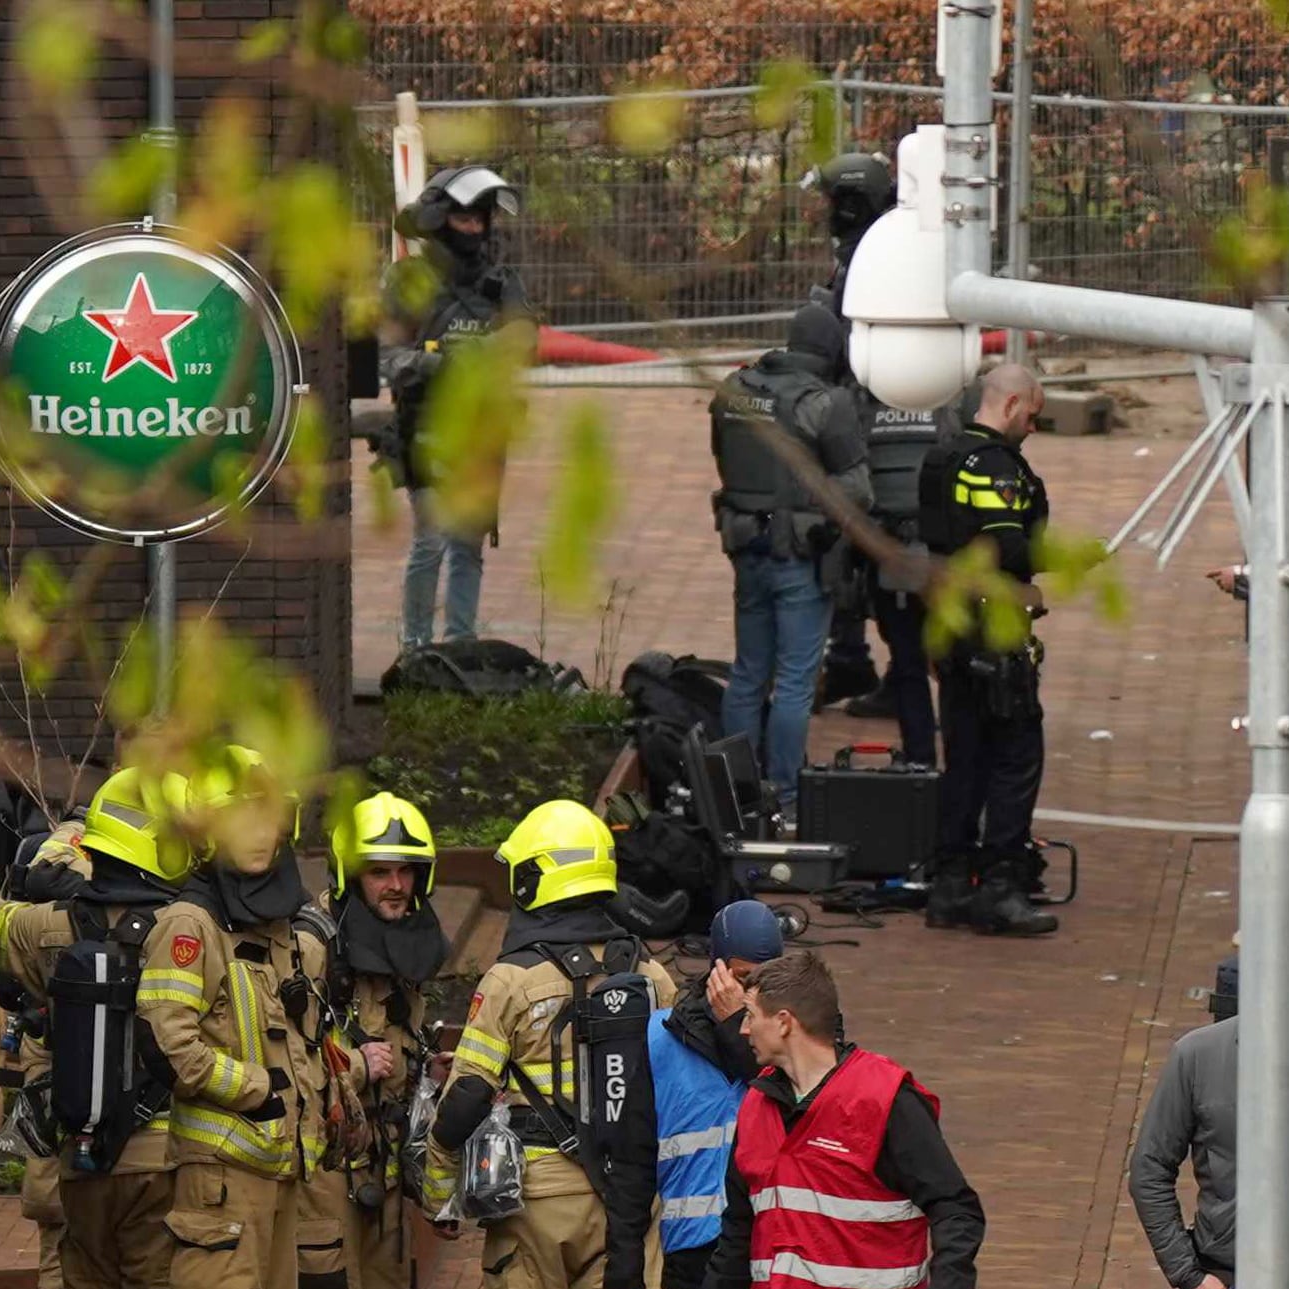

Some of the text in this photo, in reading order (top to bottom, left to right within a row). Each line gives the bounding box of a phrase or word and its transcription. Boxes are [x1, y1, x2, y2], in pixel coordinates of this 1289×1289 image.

[69, 362, 212, 375] EST. 1873
[28, 394, 254, 438] Heineken
[875, 409, 933, 424] POLITIE
